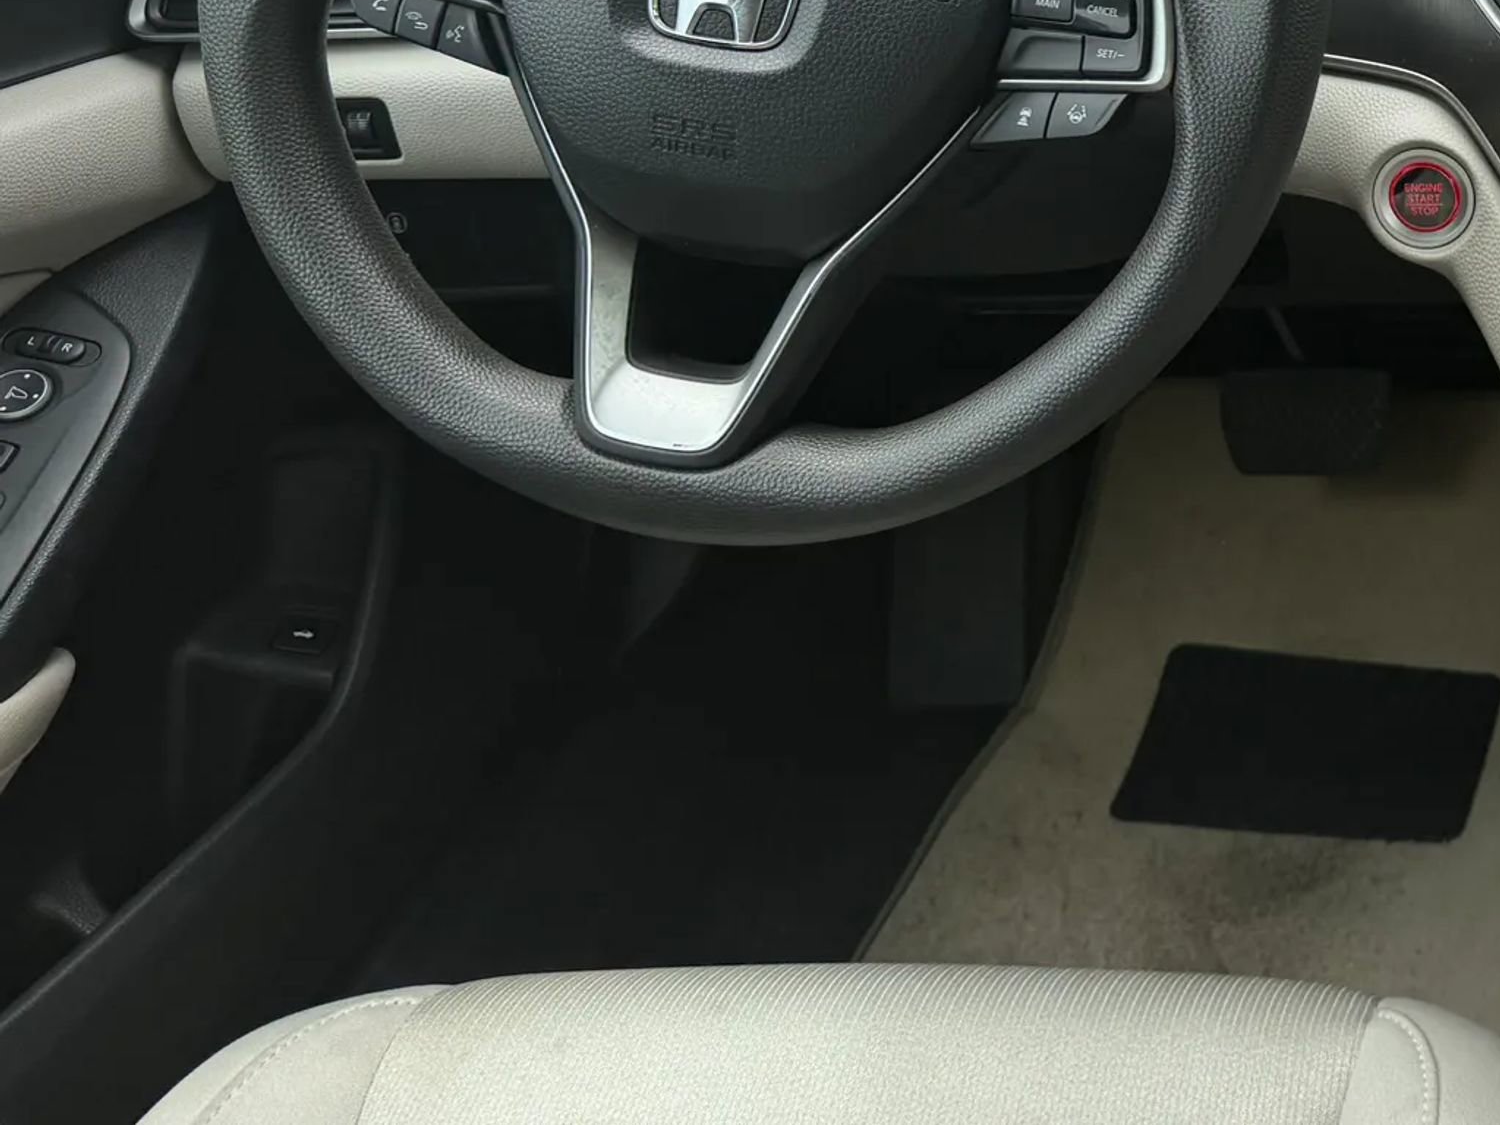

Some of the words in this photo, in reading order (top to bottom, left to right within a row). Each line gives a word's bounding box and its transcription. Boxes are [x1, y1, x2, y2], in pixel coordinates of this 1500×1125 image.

[1086, 4, 1118, 17] CANCEL
[1404, 183, 1444, 193] ENGINE
[1408, 194, 1440, 204] START
[1410, 207, 1439, 216] STOP
[27, 336, 35, 345] L
[61, 342, 73, 353] R
